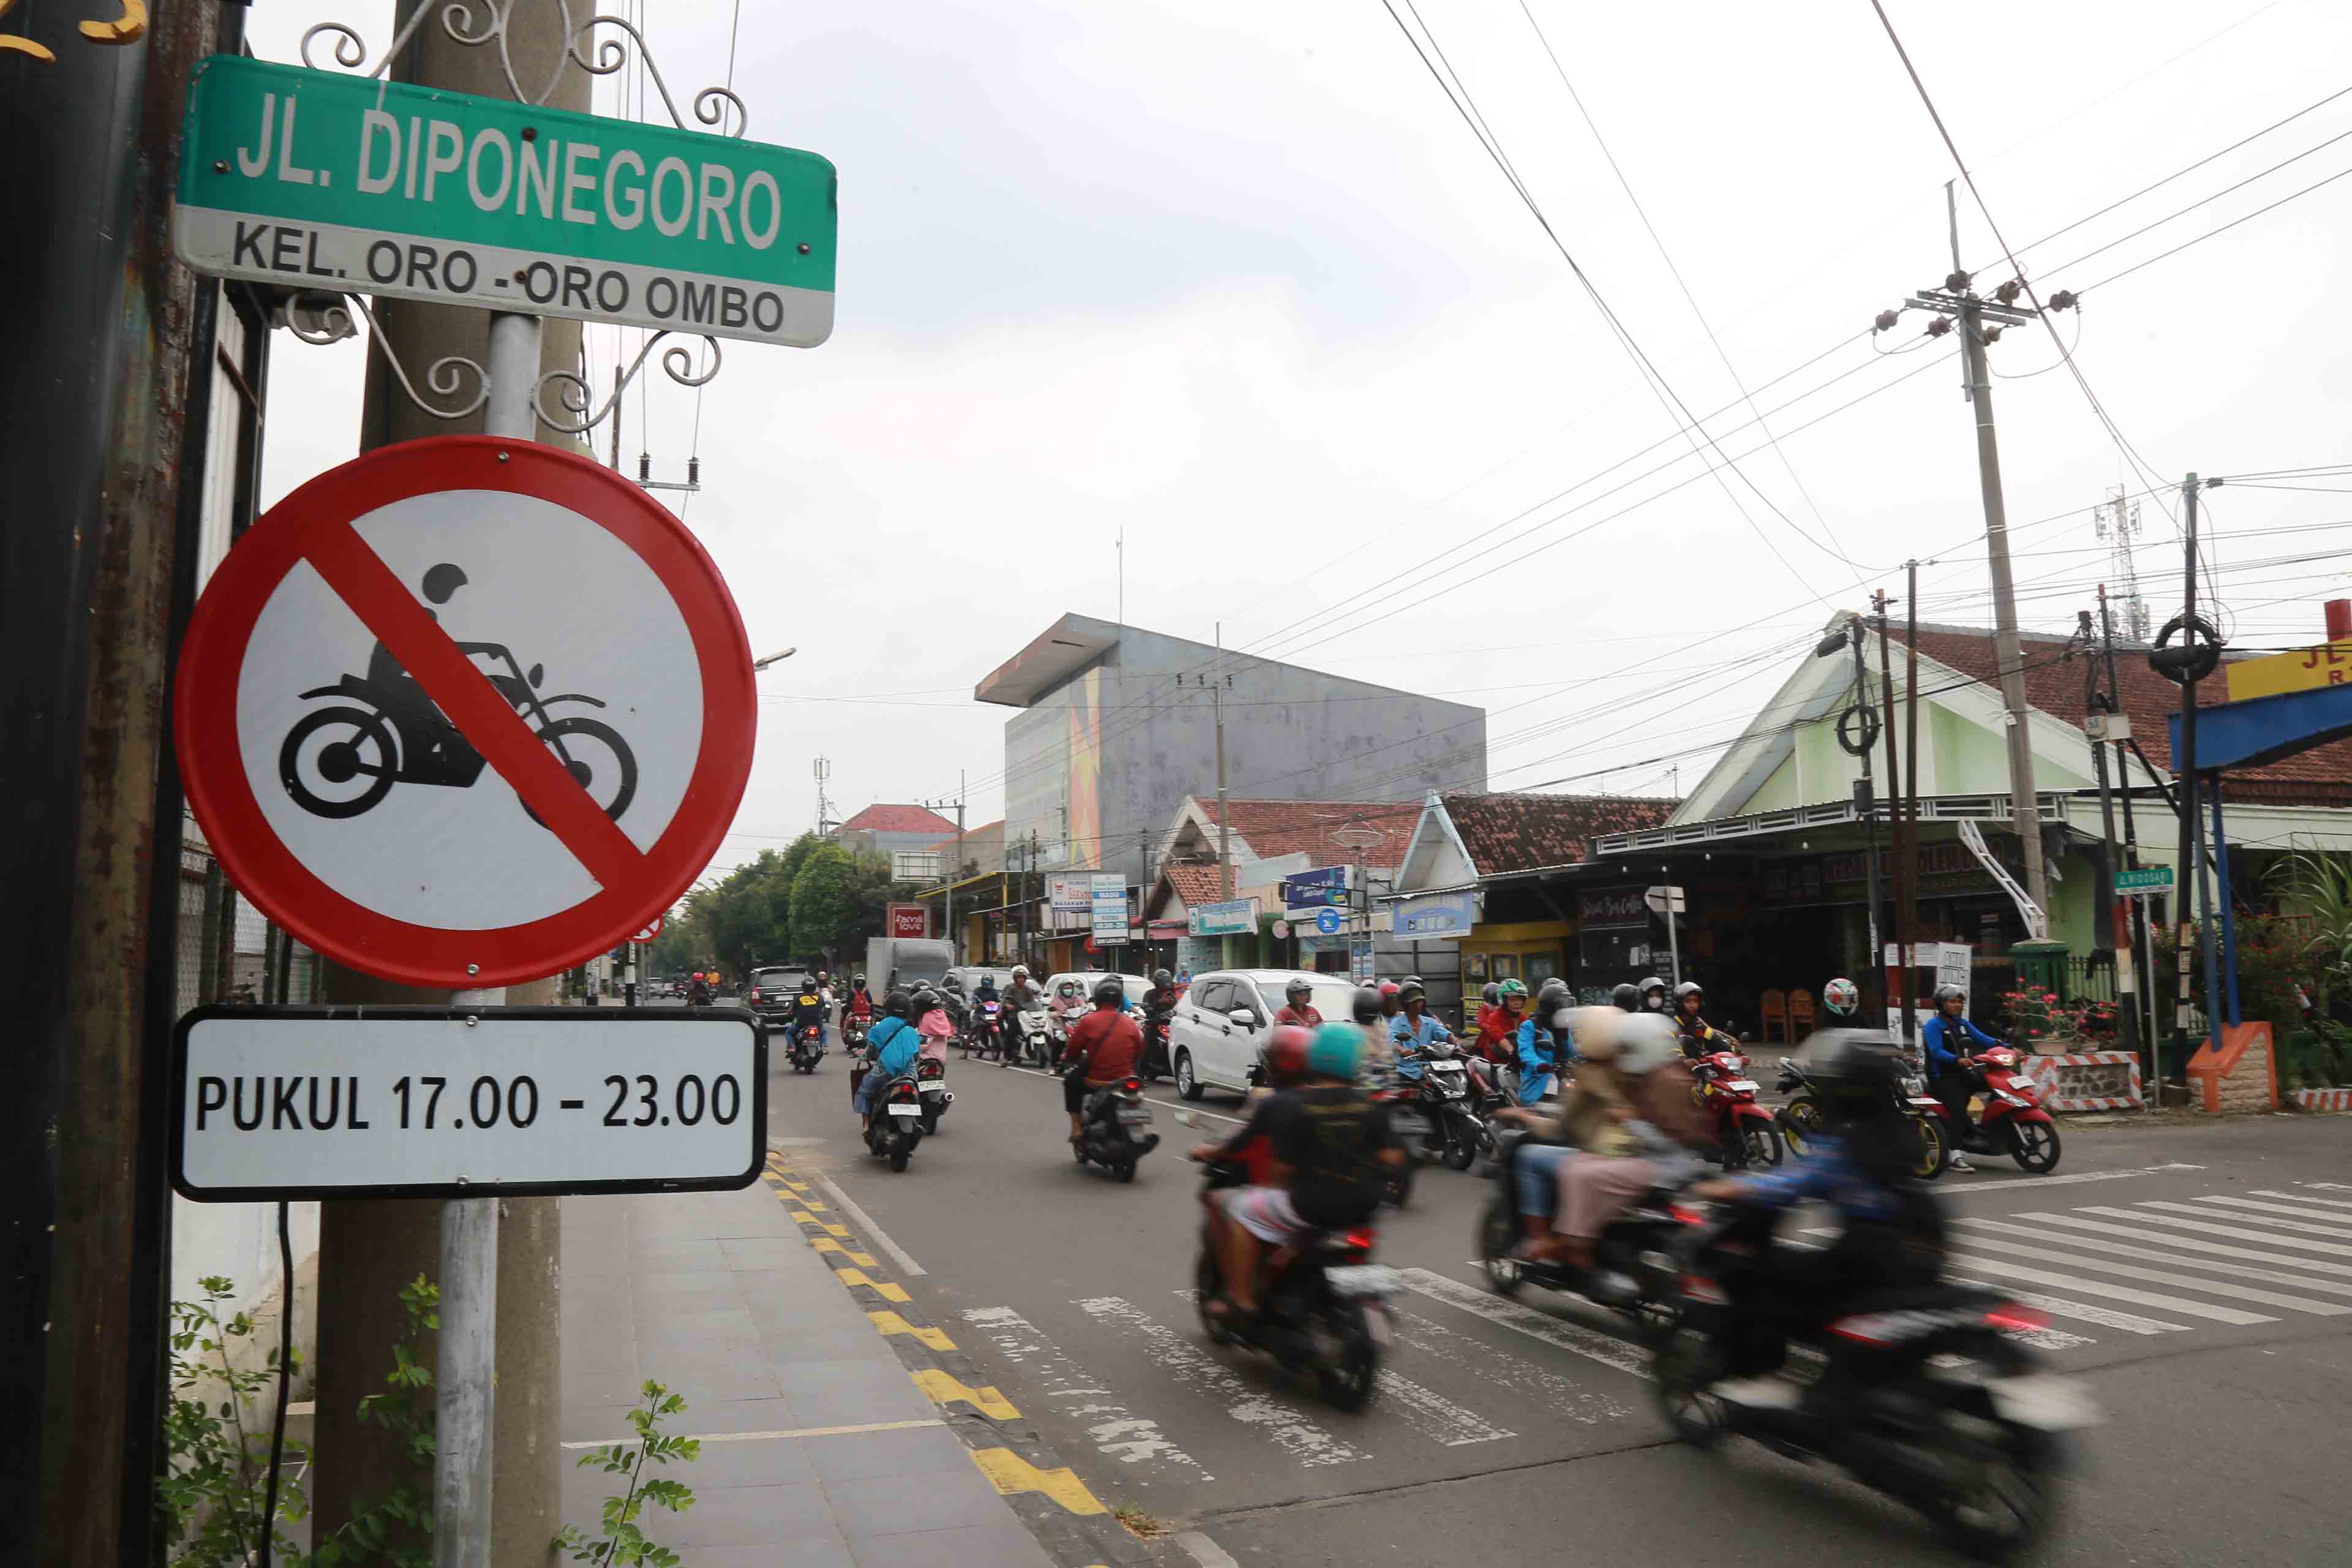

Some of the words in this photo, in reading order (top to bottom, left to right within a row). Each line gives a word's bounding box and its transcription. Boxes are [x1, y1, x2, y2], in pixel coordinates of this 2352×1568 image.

[237, 92, 330, 186] JL.
[356, 109, 781, 250] DIPONEGORO
[233, 221, 346, 279] KEL.
[366, 239, 477, 294] ORO
[494, 278, 508, 288] -
[524, 261, 629, 313] ORO
[646, 277, 783, 333] OMBO
[196, 1076, 369, 1131] PUKUL
[393, 1075, 539, 1130] 17.00
[560, 1100, 584, 1109] -
[603, 1074, 740, 1127] 23.00
